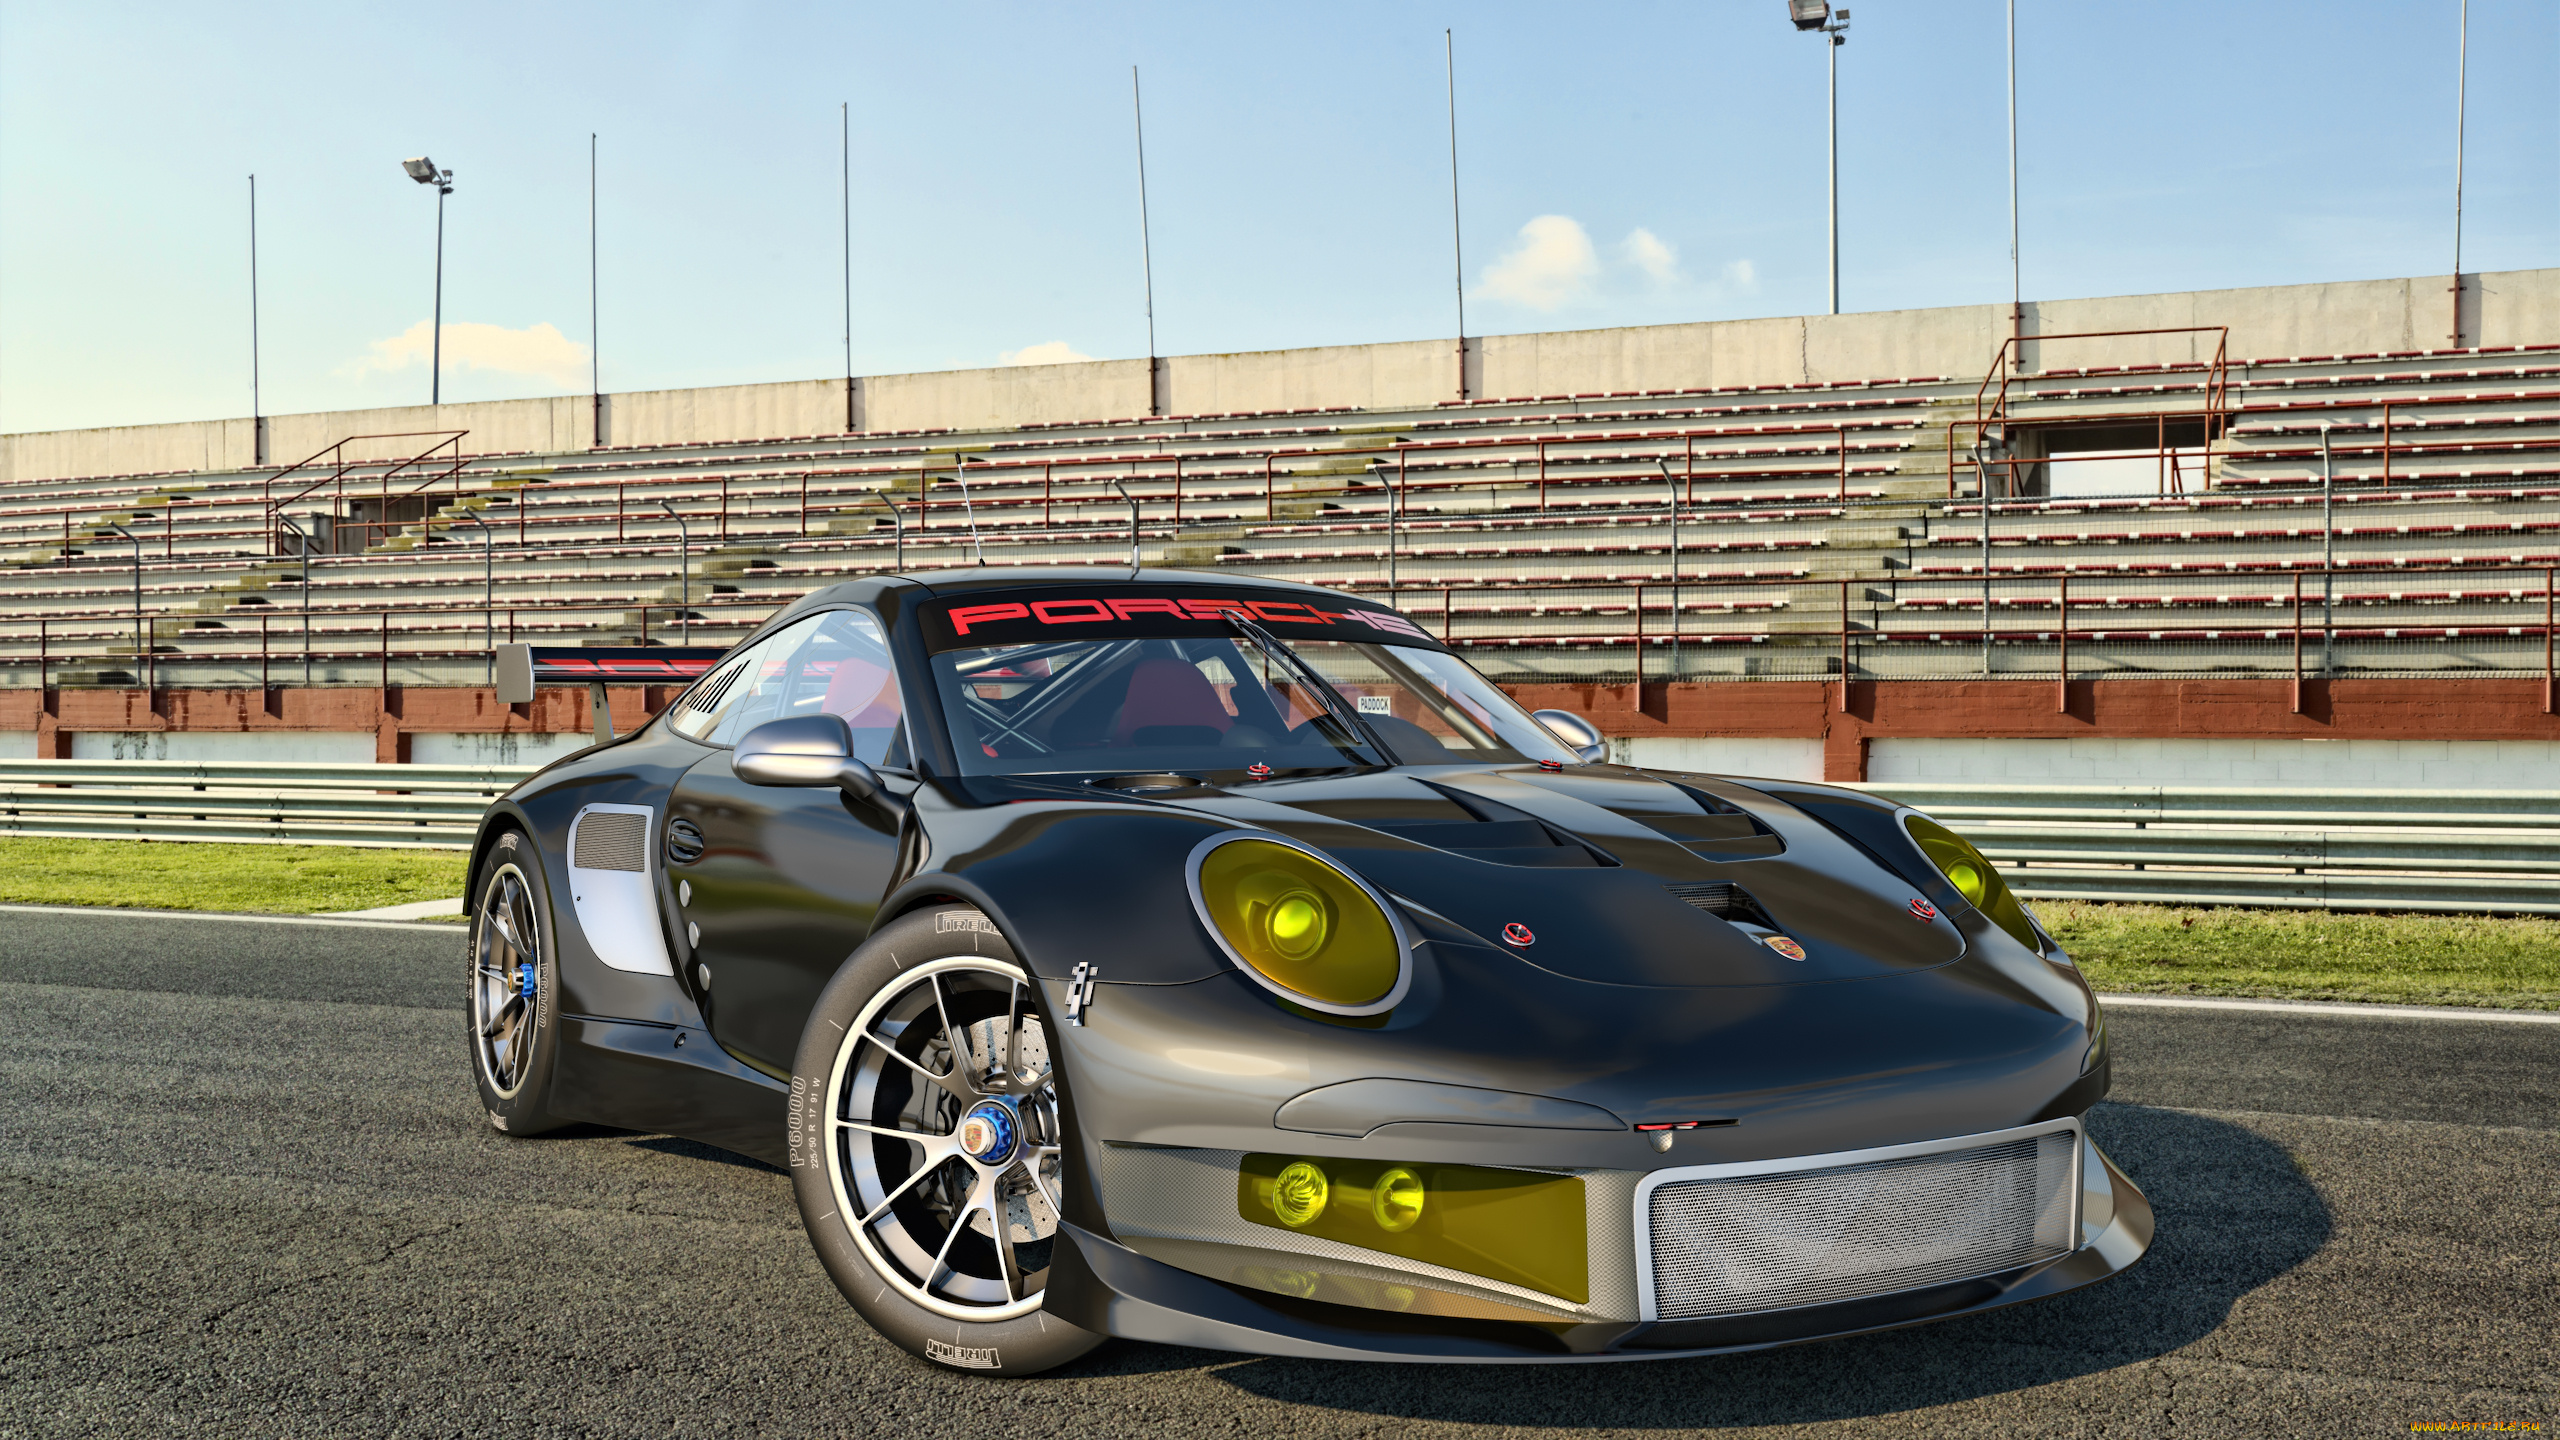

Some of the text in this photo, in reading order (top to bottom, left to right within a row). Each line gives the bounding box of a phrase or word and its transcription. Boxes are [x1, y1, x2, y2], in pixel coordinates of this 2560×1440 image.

[948, 599, 1432, 641] PORSCHE
[1361, 698, 1388, 710] PADDOCK
[935, 910, 1002, 936] PIRELL
[788, 1076, 806, 1166] P6000
[808, 1077, 820, 1169] 225/50 R 17 91 W
[926, 1339, 1001, 1368] PIRELLI
